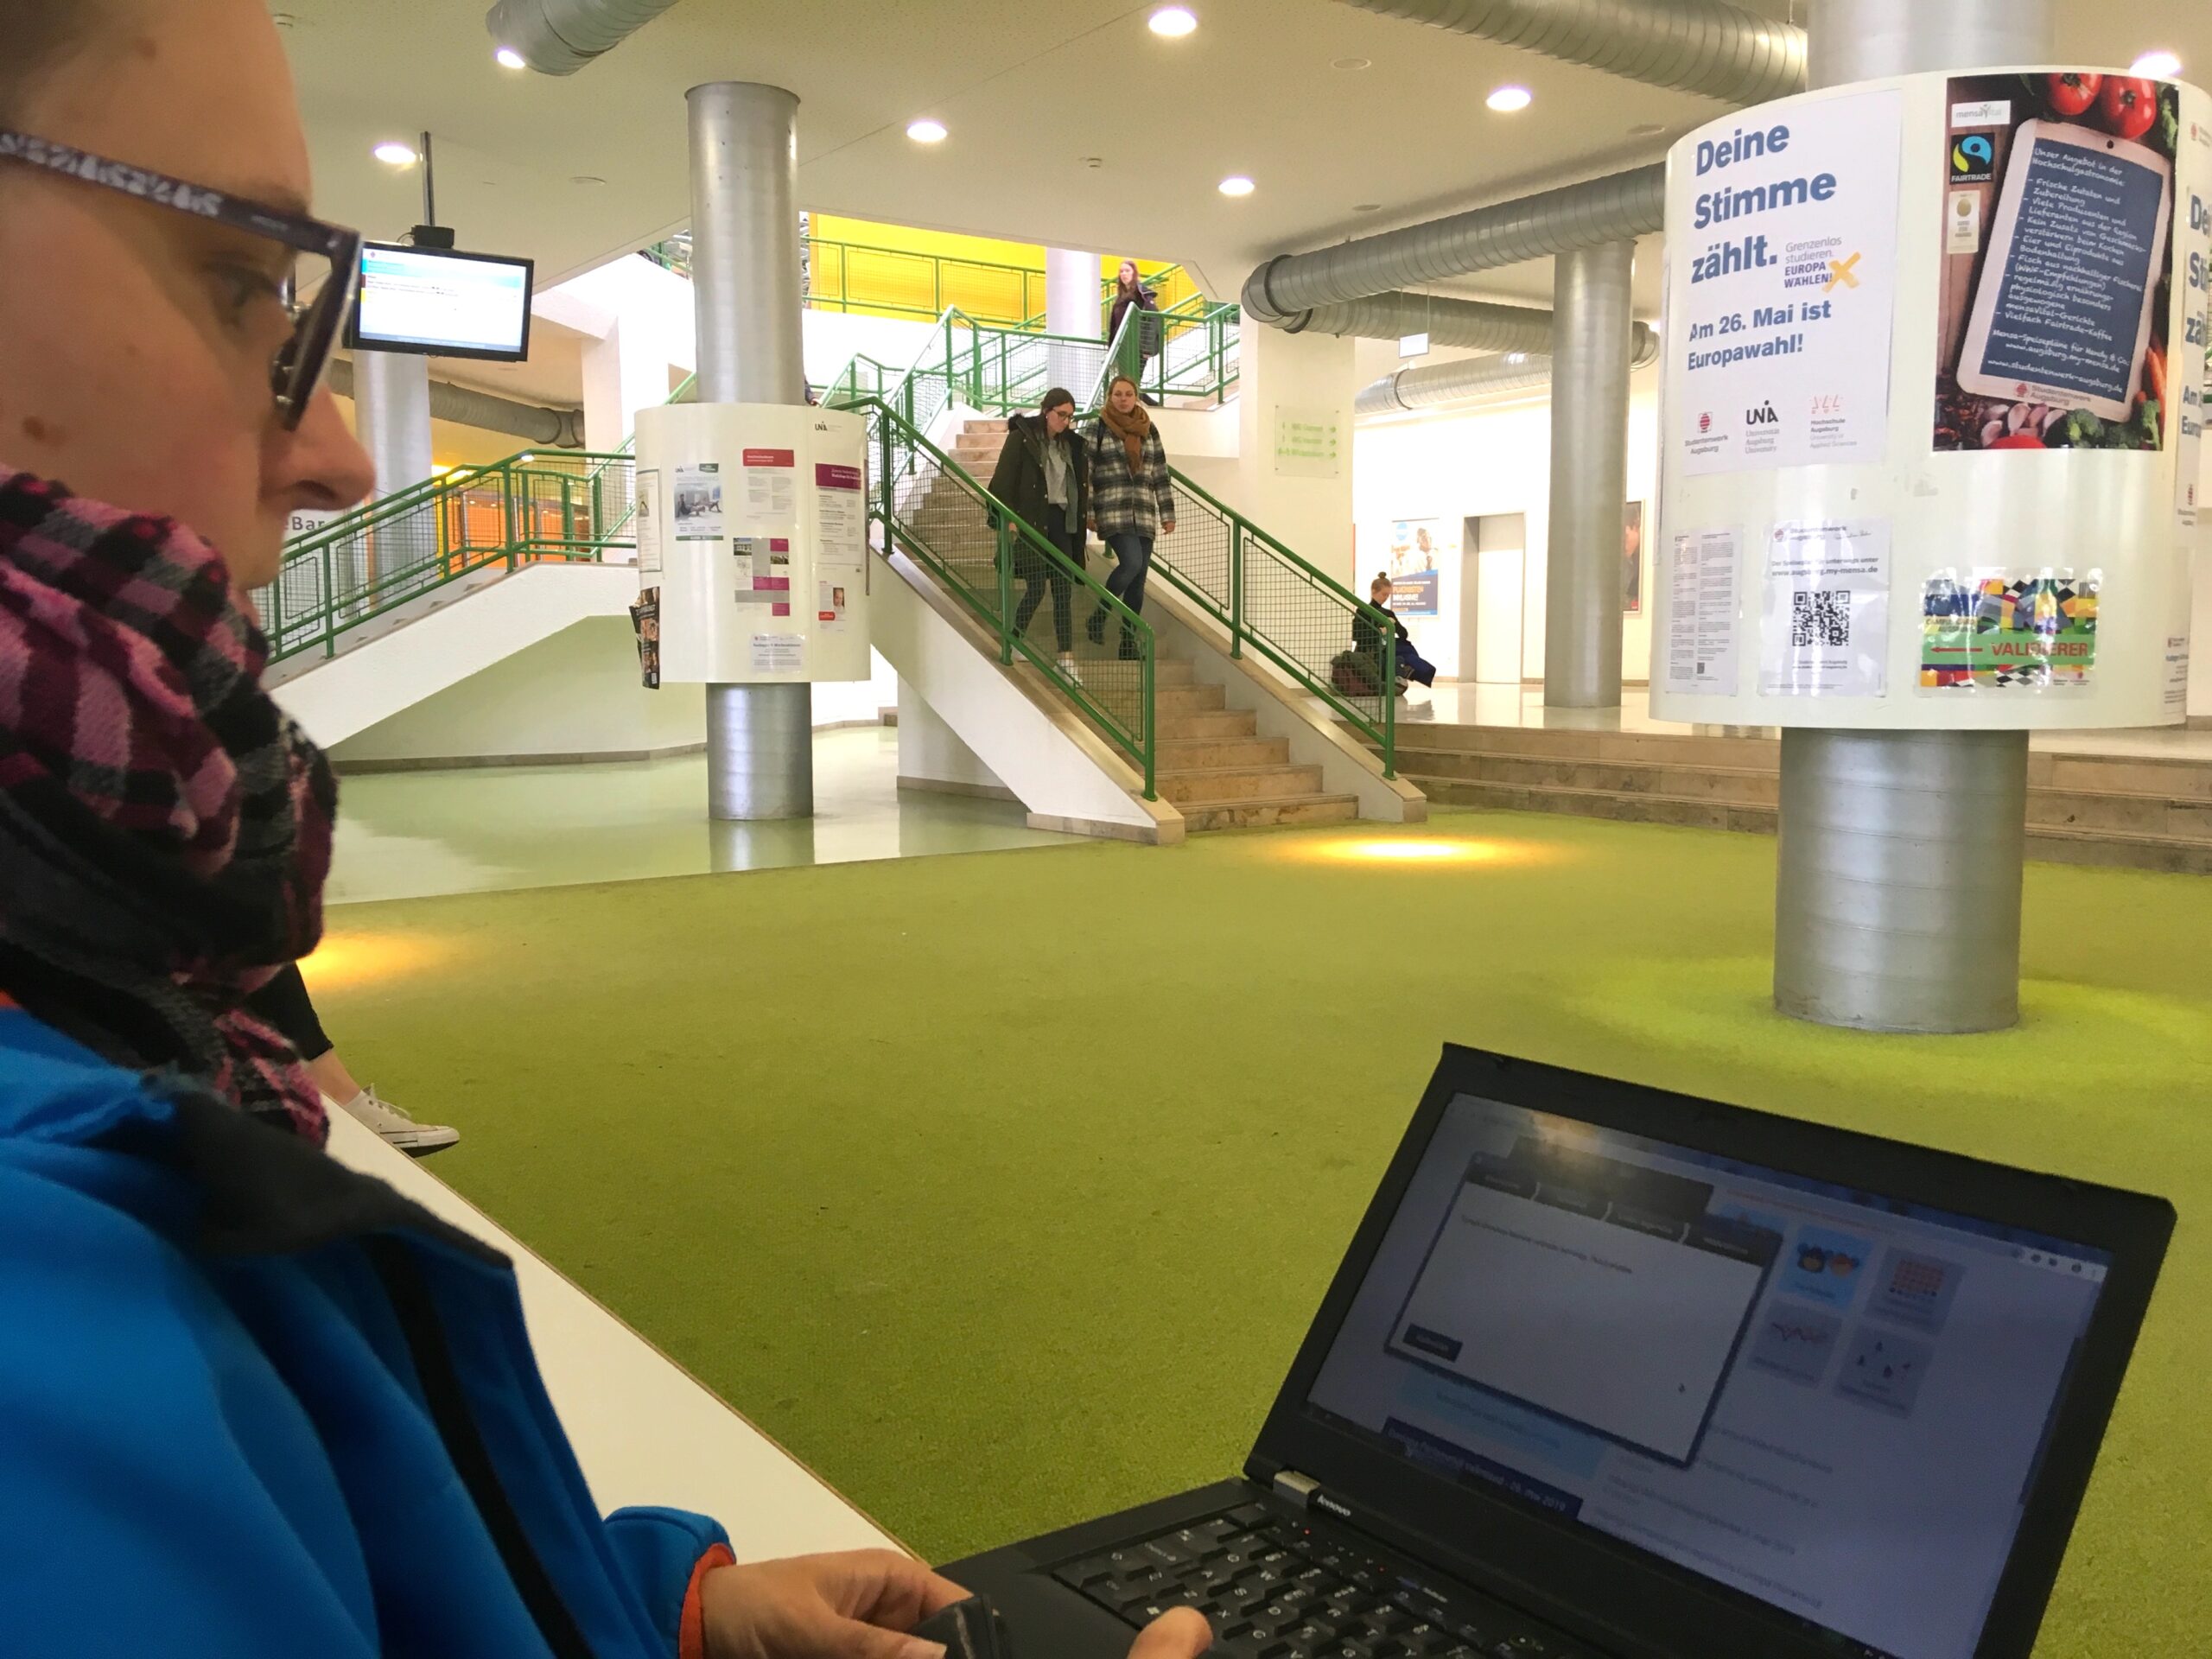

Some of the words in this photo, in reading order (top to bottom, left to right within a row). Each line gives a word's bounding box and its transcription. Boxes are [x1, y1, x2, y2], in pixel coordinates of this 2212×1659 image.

[1696, 124, 1789, 176] Deine
[2034, 149, 2060, 159] Unser
[2063, 154, 2095, 168] Angebot
[2098, 162, 2107, 170] in
[2108, 165, 2122, 175] der
[1951, 173, 1991, 181] FAIRTRADE
[1694, 173, 1837, 230] Stimme
[2032, 188, 2086, 207] Zubereitung
[2036, 178, 2068, 192] Frische
[2070, 185, 2102, 200] Zutaten
[2105, 195, 2120, 205] und
[2029, 207, 2078, 224] Lieferanten
[2082, 219, 2095, 228] aus
[2097, 222, 2112, 232] der
[2031, 197, 2054, 208] Viele
[2111, 217, 2126, 226] und
[2026, 216, 2046, 226] Kein
[2050, 220, 2078, 233] Zusatz
[1785, 236, 1842, 252] Grenzenlos
[2023, 235, 2042, 245] Eier
[2044, 239, 2062, 249] und
[2098, 242, 2124, 256] Kochen
[1691, 234, 1777, 284] zählt.
[1785, 249, 1834, 264] studieren.
[2019, 245, 2081, 265] Bodenhaltung
[1783, 271, 1833, 289] WÄHLEN!
[1784, 262, 1826, 276] EUROPA
[2015, 263, 2107, 291] (WWF-Empfehlungen)
[2018, 254, 2043, 265] Fisch
[2045, 261, 2061, 270] aus
[2063, 264, 2111, 282] nachhaltiger
[2008, 294, 2066, 310] ausgewogene
[2010, 283, 2070, 301] physiologisch
[2073, 296, 2112, 311] besonders
[1688, 322, 1713, 342] Am
[1719, 313, 1746, 335] 26.
[1752, 303, 1794, 328] Mai
[1802, 300, 1832, 321] ist
[2005, 311, 2042, 325] Vielfach
[2044, 318, 2113, 342] Fairtrade-Kaffee
[1688, 334, 1803, 371] Europawahl!
[2005, 342, 2120, 373] www.augsburg.my-mensa.de
[2071, 341, 2083, 353] für
[2085, 347, 2108, 362] Handy
[1987, 359, 2123, 393] www.studentenwerk-augsburg.de
[1772, 566, 1878, 576] www.augsbg.my-mensa.de
